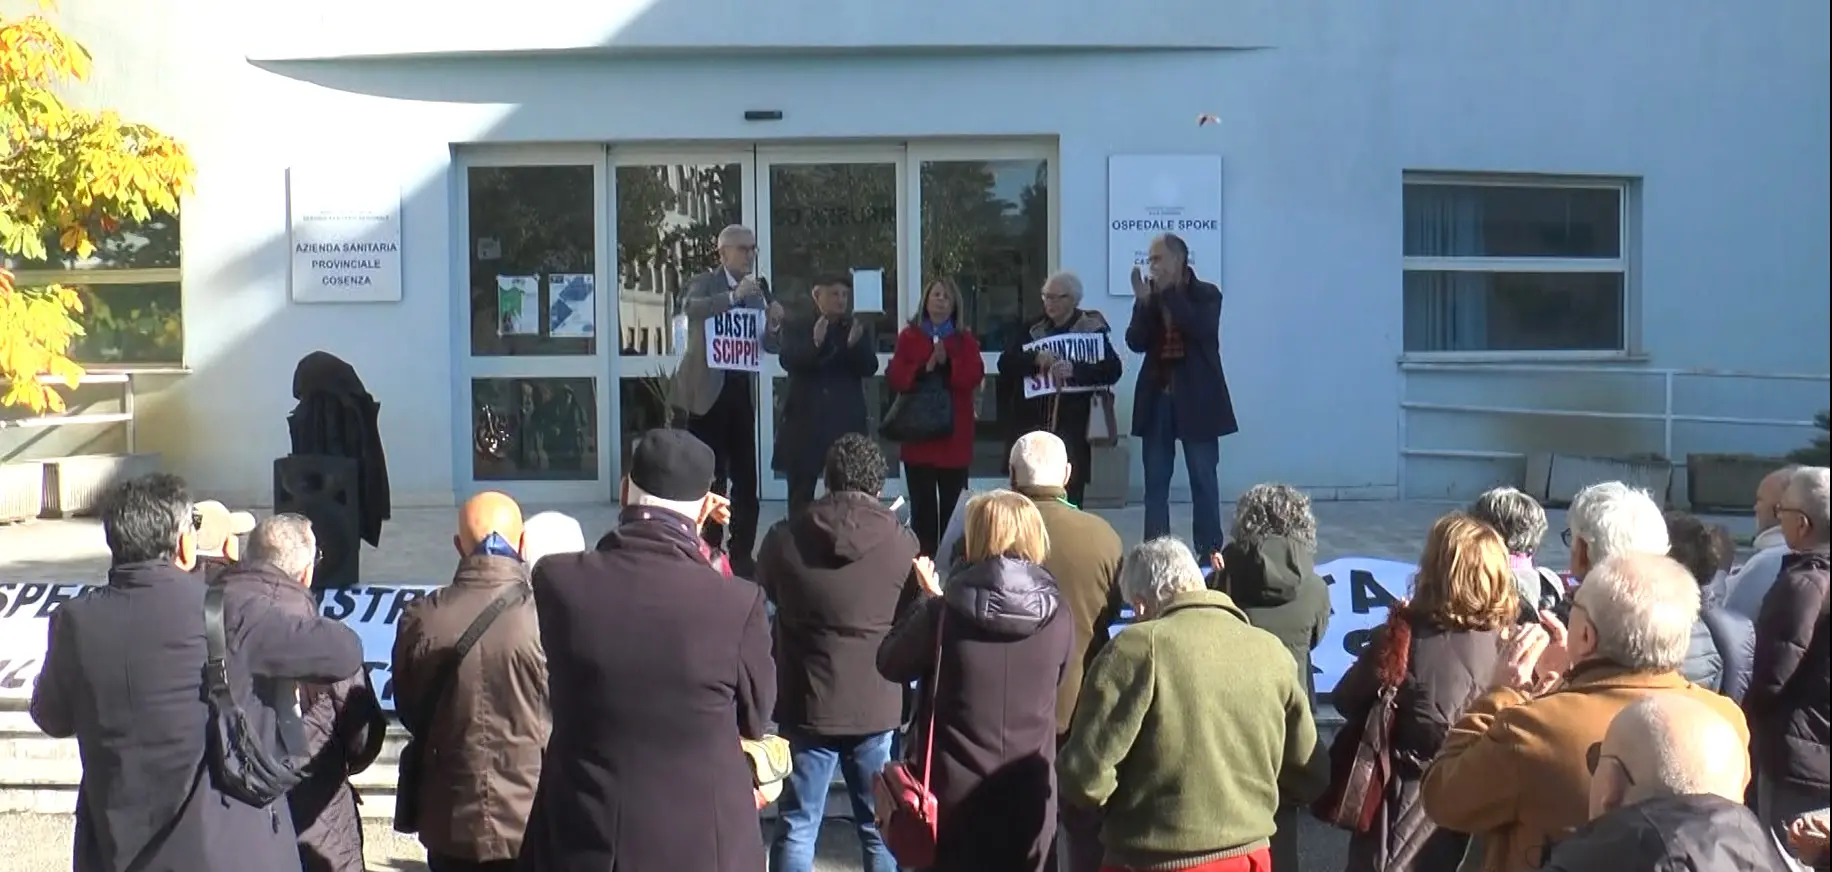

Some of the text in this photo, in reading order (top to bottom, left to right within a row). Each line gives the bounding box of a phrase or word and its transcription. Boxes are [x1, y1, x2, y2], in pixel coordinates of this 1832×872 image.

[1112, 219, 1218, 231] OSPEDALE SPOKE
[295, 242, 398, 254] AZIENDA SANITARIA
[311, 259, 381, 269] PROVINCIALE
[322, 275, 372, 286] COSENZA
[714, 311, 757, 339] BASTA
[712, 338, 759, 366] SCIPPI!
